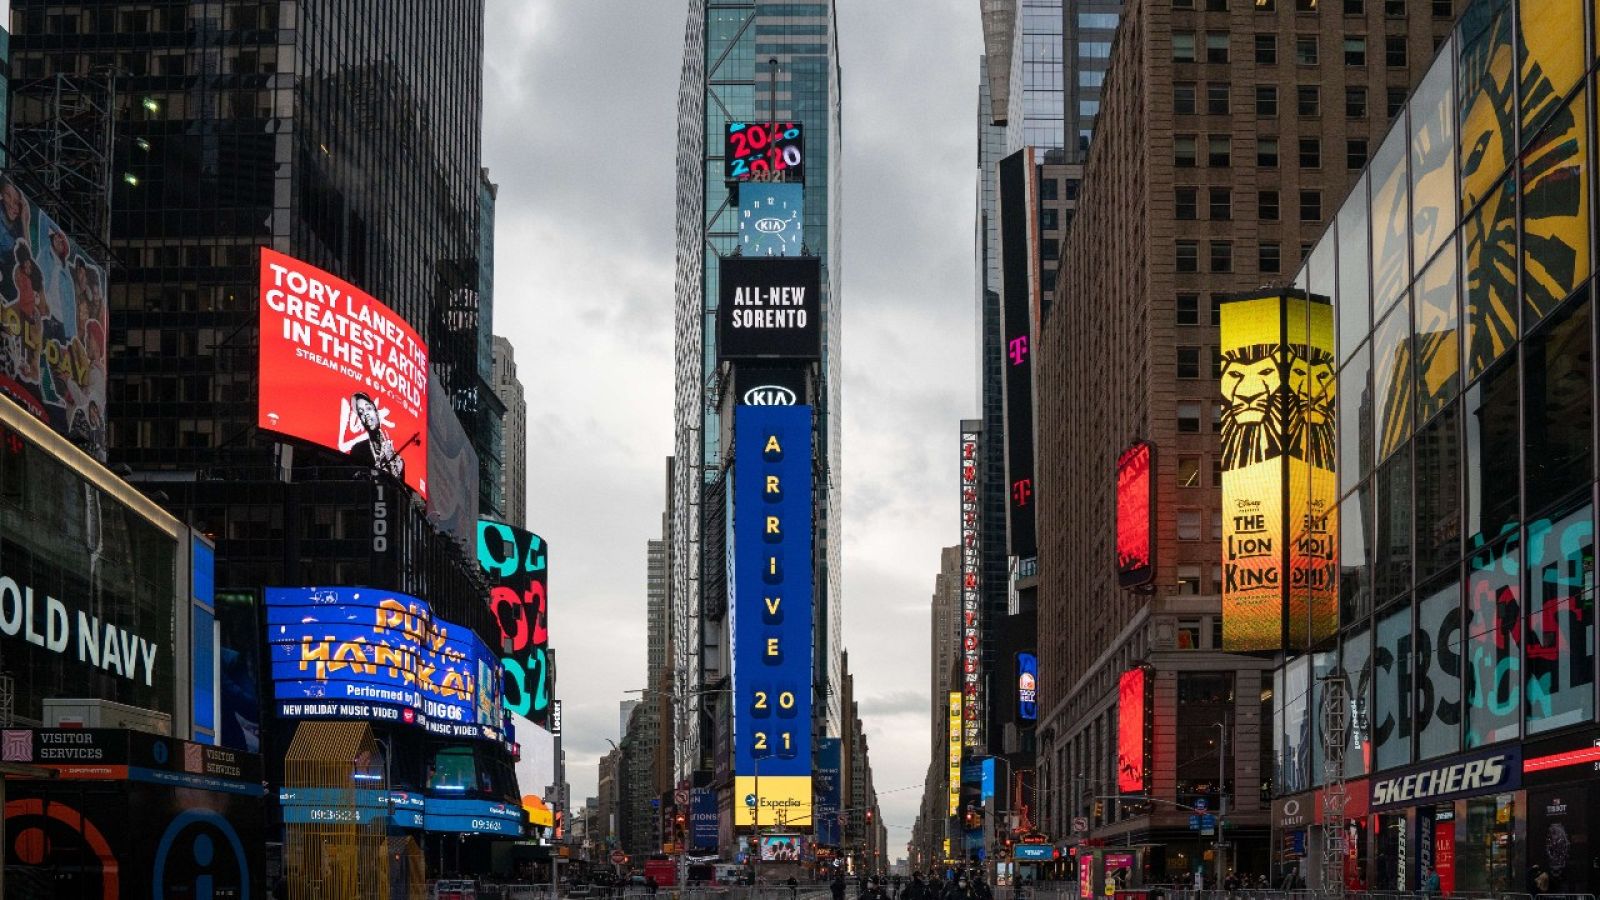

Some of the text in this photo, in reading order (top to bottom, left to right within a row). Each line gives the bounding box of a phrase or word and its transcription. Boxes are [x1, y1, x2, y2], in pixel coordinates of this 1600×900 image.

[760, 220, 780, 231] KIA
[734, 286, 806, 306] ALL-NEW
[270, 263, 427, 374] TORY LANEZ THE
[732, 309, 807, 329] SORENTO
[265, 289, 427, 395] GREATEST ARTIST
[283, 318, 423, 413] IN THE WORLD.
[295, 347, 363, 382] STREAM NOW
[751, 390, 789, 406] KIA
[373, 485, 388, 552] 1500
[1233, 514, 1264, 530] THE
[765, 435, 781, 657] ARRIVE
[1228, 534, 1272, 561] LION
[1224, 563, 1279, 594] KING
[0, 575, 158, 687] OLD NAVY
[441, 646, 466, 665] for
[346, 684, 402, 701] Performed
[283, 704, 398, 720] NEW HOLIDAY MUSIC VIDEO
[429, 700, 462, 721] DIGGS
[40, 733, 94, 744] VISITOR
[454, 725, 478, 736] VIDEO
[40, 748, 103, 759] SERVICES
[206, 749, 235, 763] VISITOR
[206, 762, 241, 776] SERVICES
[1372, 755, 1505, 806] SKECHERS
[760, 797, 801, 810] Expedia
